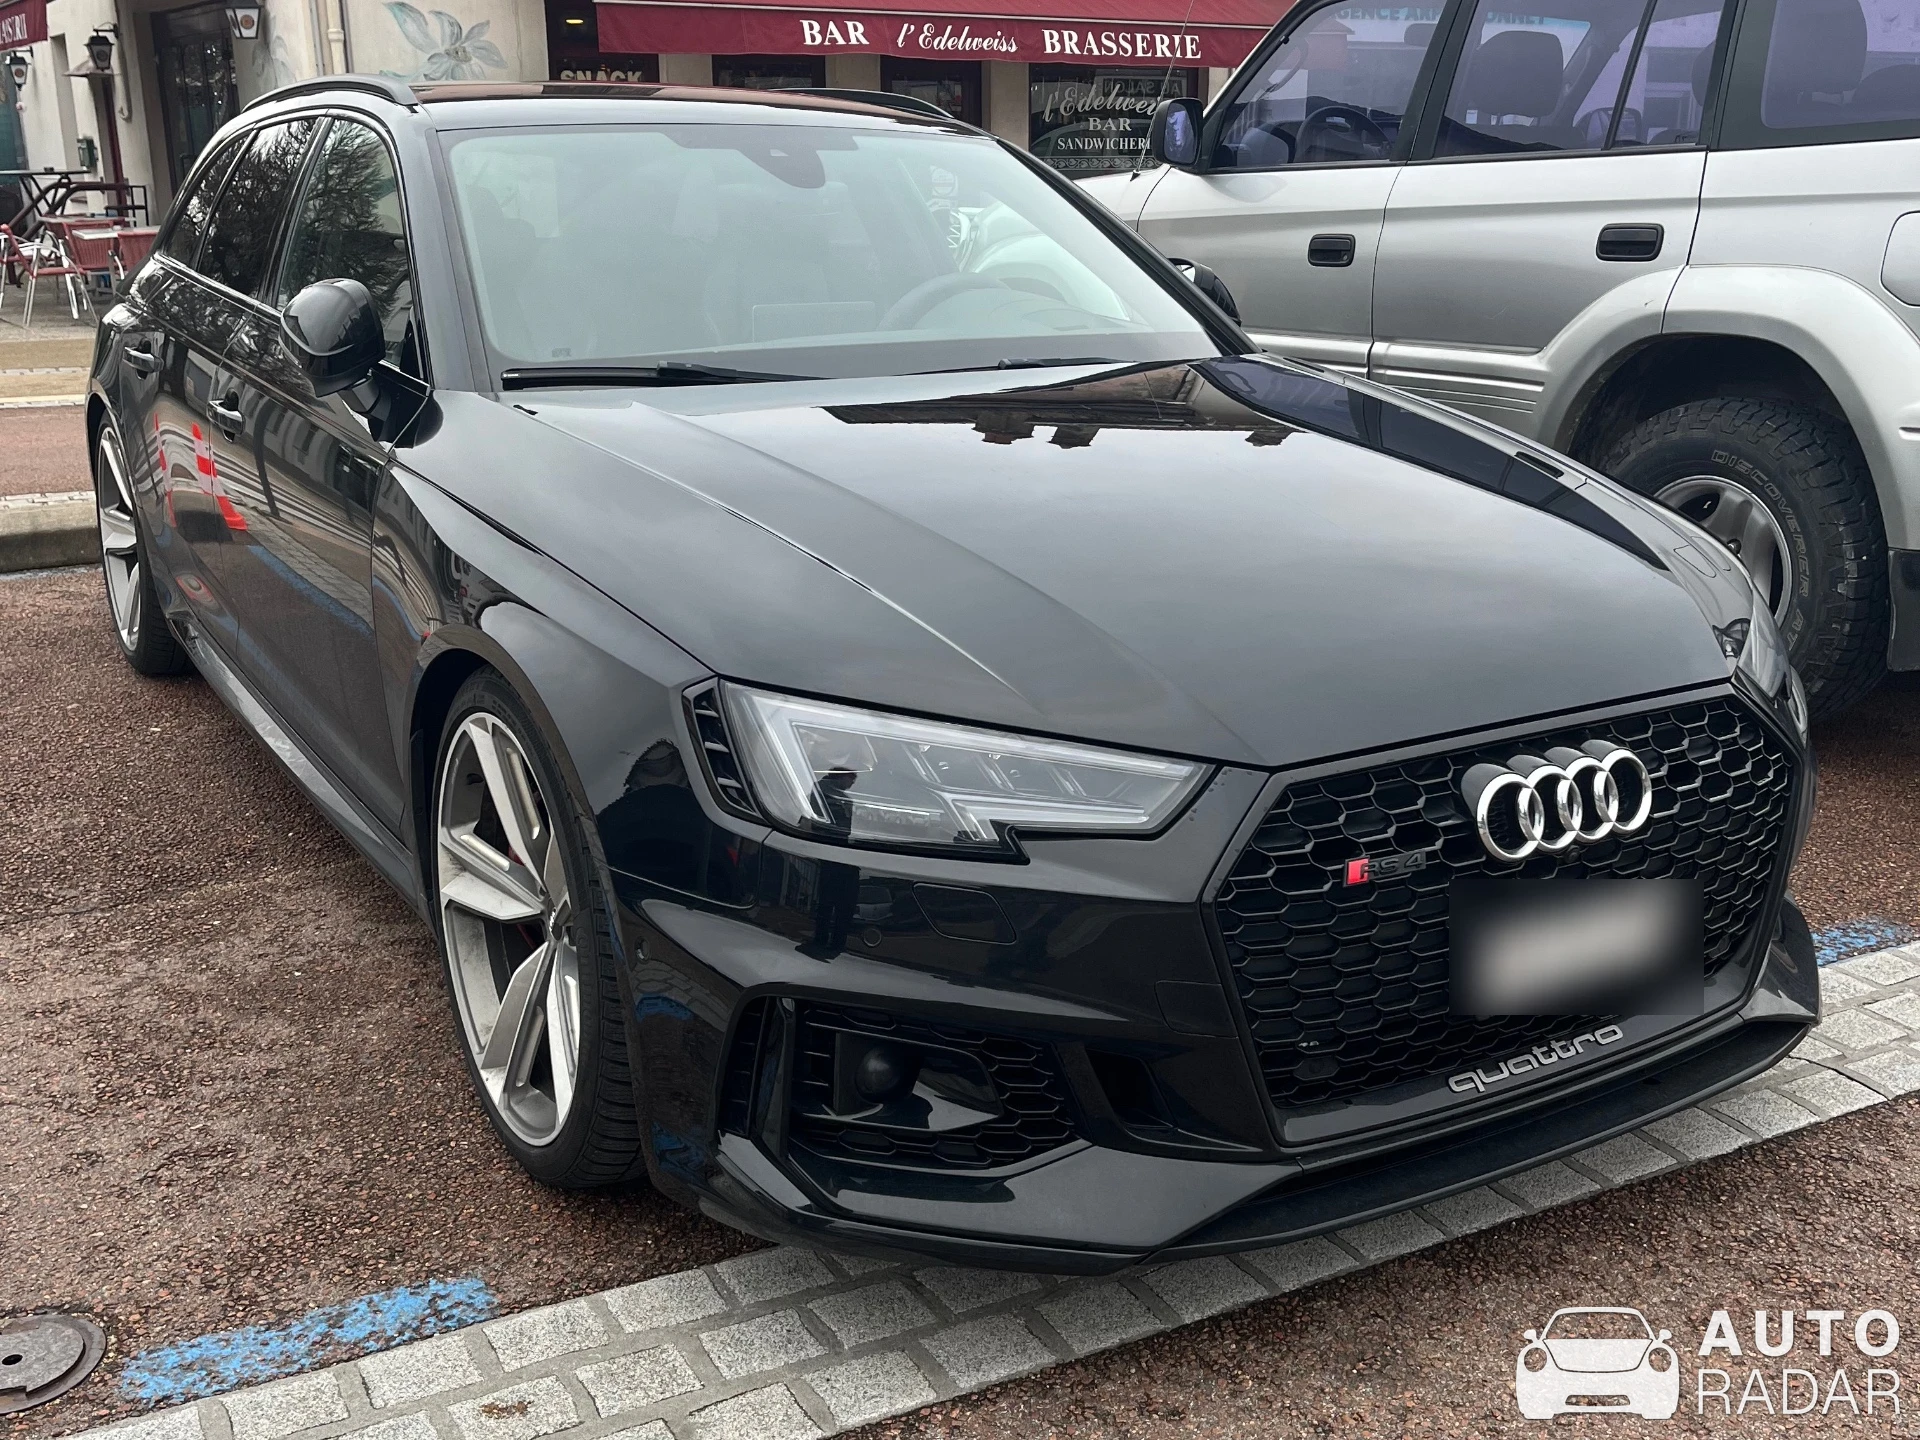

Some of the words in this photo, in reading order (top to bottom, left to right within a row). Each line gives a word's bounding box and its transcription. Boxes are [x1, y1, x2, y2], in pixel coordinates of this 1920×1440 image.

[800, 19, 869, 45] BAR
[897, 23, 1018, 52] l'Edelweiss
[1042, 29, 1201, 59] BRASSERIE
[1042, 83, 1159, 122] l'Edelwei
[1057, 137, 1151, 150] SANDWICHERI
[1088, 117, 1132, 131] BAR
[1711, 449, 1810, 598] DISCOVERER
[1448, 1024, 1624, 1093] quattro
